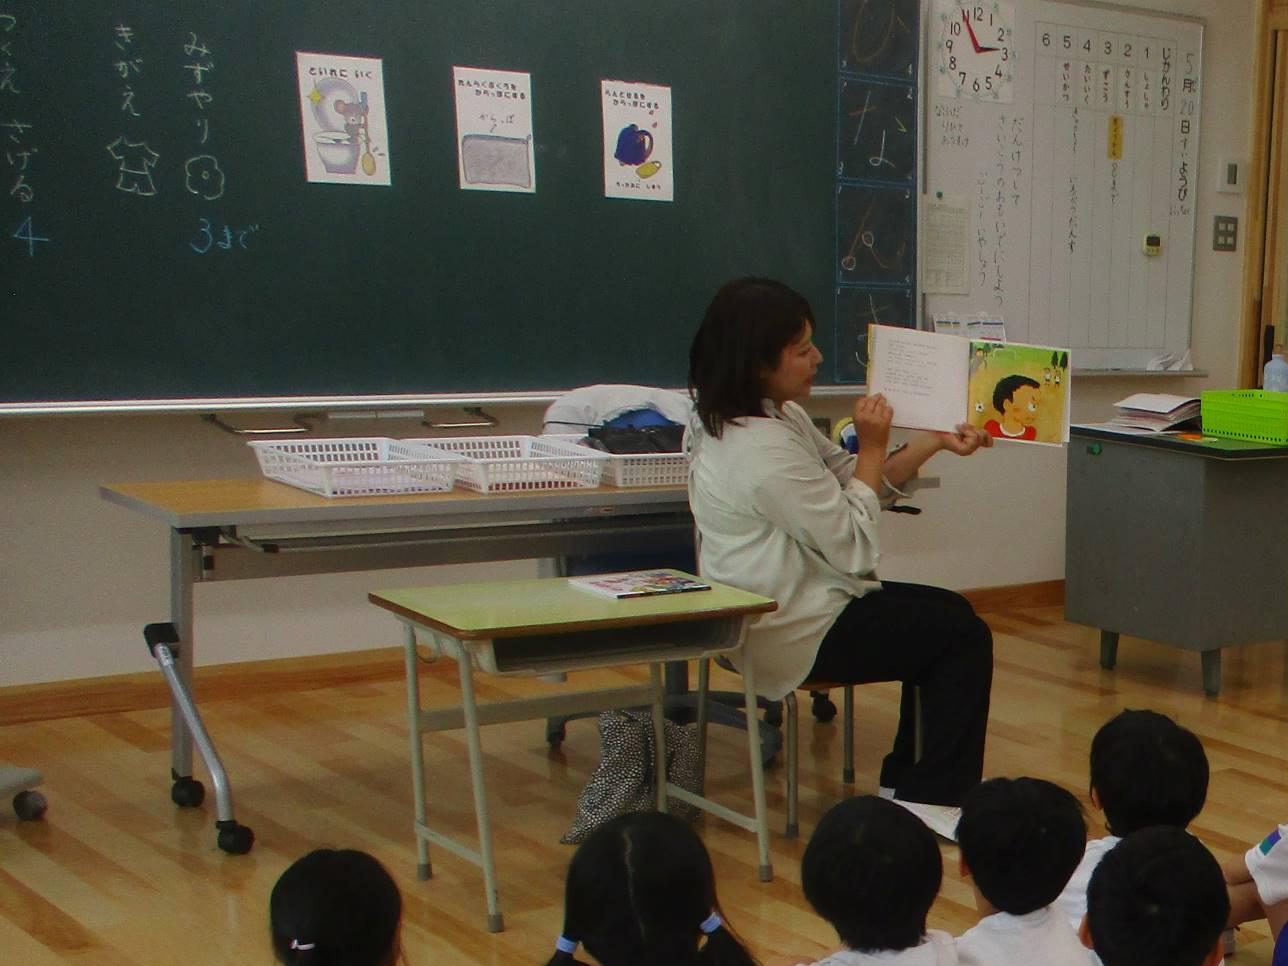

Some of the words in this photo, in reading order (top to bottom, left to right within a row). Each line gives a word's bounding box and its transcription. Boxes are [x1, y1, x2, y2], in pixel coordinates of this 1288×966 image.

[973, 6, 984, 22] 12
[989, 12, 993, 27] 1
[950, 21, 961, 36] 10
[996, 26, 1006, 42] 2
[945, 39, 954, 54] 9
[1042, 32, 1051, 47] 6
[1063, 35, 1072, 50] 5
[1082, 39, 1092, 54] 4
[1000, 46, 1009, 62] 3
[1103, 40, 1112, 56] 3
[1123, 43, 1132, 58] 2
[1144, 46, 1149, 61] 1
[112, 23, 144, 117] きがえ
[948, 55, 957, 71] 8
[958, 71, 967, 86] 7
[994, 64, 1003, 79] 4
[1160, 47, 1172, 111] じかんわり
[182, 31, 215, 145] みずやり
[972, 77, 980, 93] 6
[985, 75, 993, 91] 5
[13, 215, 51, 257] 4
